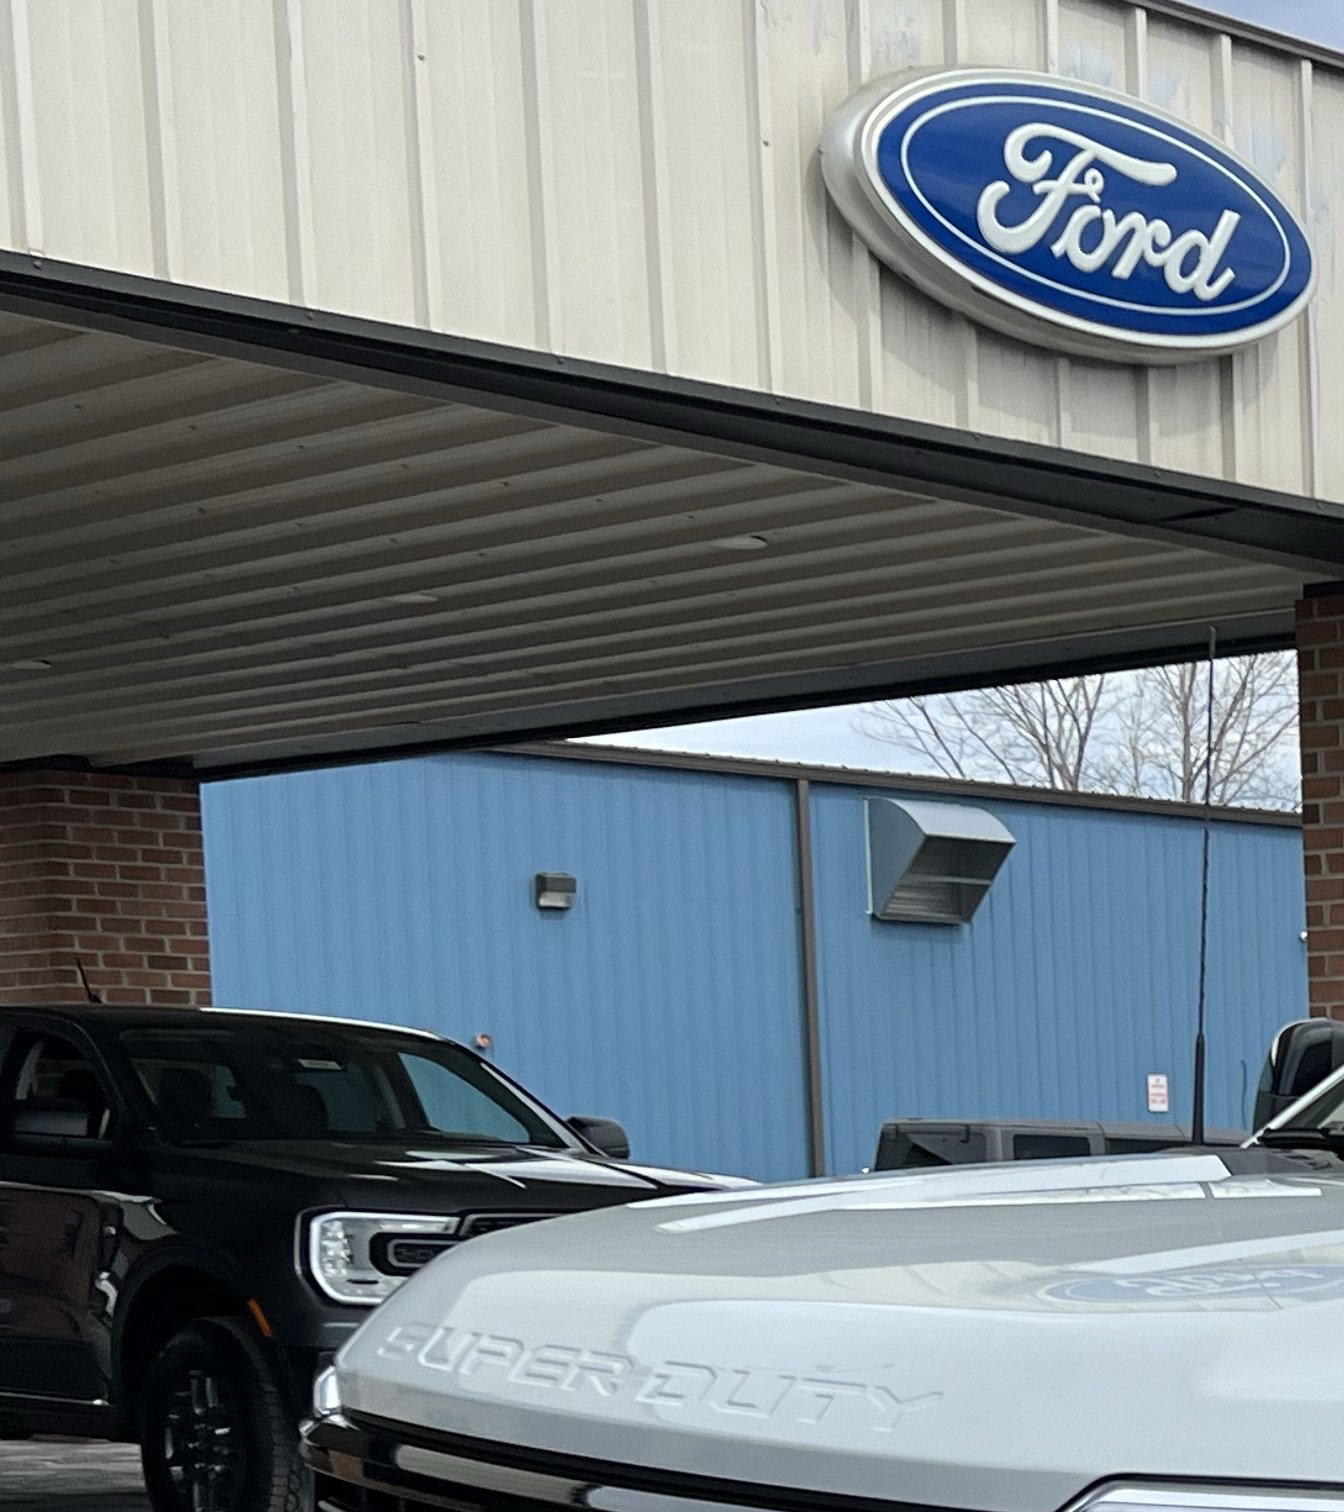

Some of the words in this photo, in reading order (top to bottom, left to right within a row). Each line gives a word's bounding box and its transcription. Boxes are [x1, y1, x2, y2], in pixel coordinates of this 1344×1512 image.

[977, 121, 1241, 301] Ford
[376, 1320, 642, 1398] SUPER
[635, 1359, 945, 1433] DUTY
